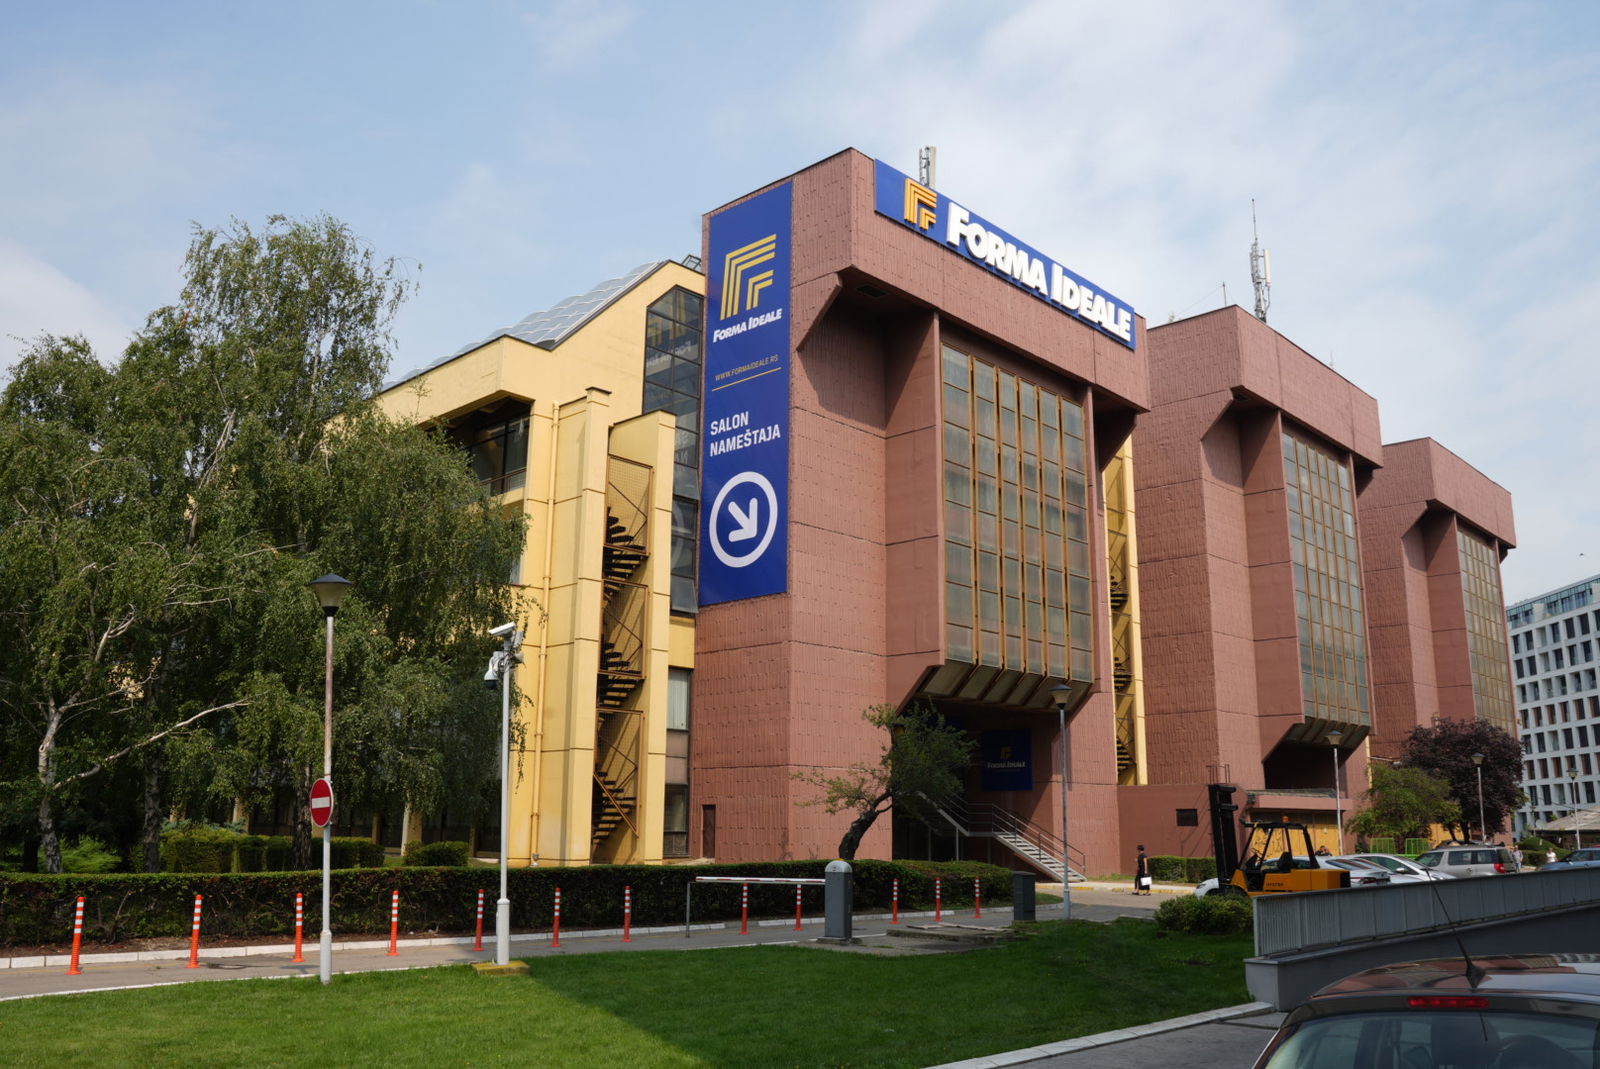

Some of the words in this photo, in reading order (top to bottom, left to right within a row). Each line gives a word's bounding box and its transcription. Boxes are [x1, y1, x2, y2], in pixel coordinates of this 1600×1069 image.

[947, 202, 1048, 296] FORMA
[1051, 263, 1131, 342] IDEALE
[713, 322, 747, 343] FORMA
[748, 309, 782, 330] IDEALE
[715, 354, 779, 381] WWW.FORMAIDEALE.RS
[710, 411, 749, 436] SALON
[710, 424, 781, 457] NAMEŠTAJA
